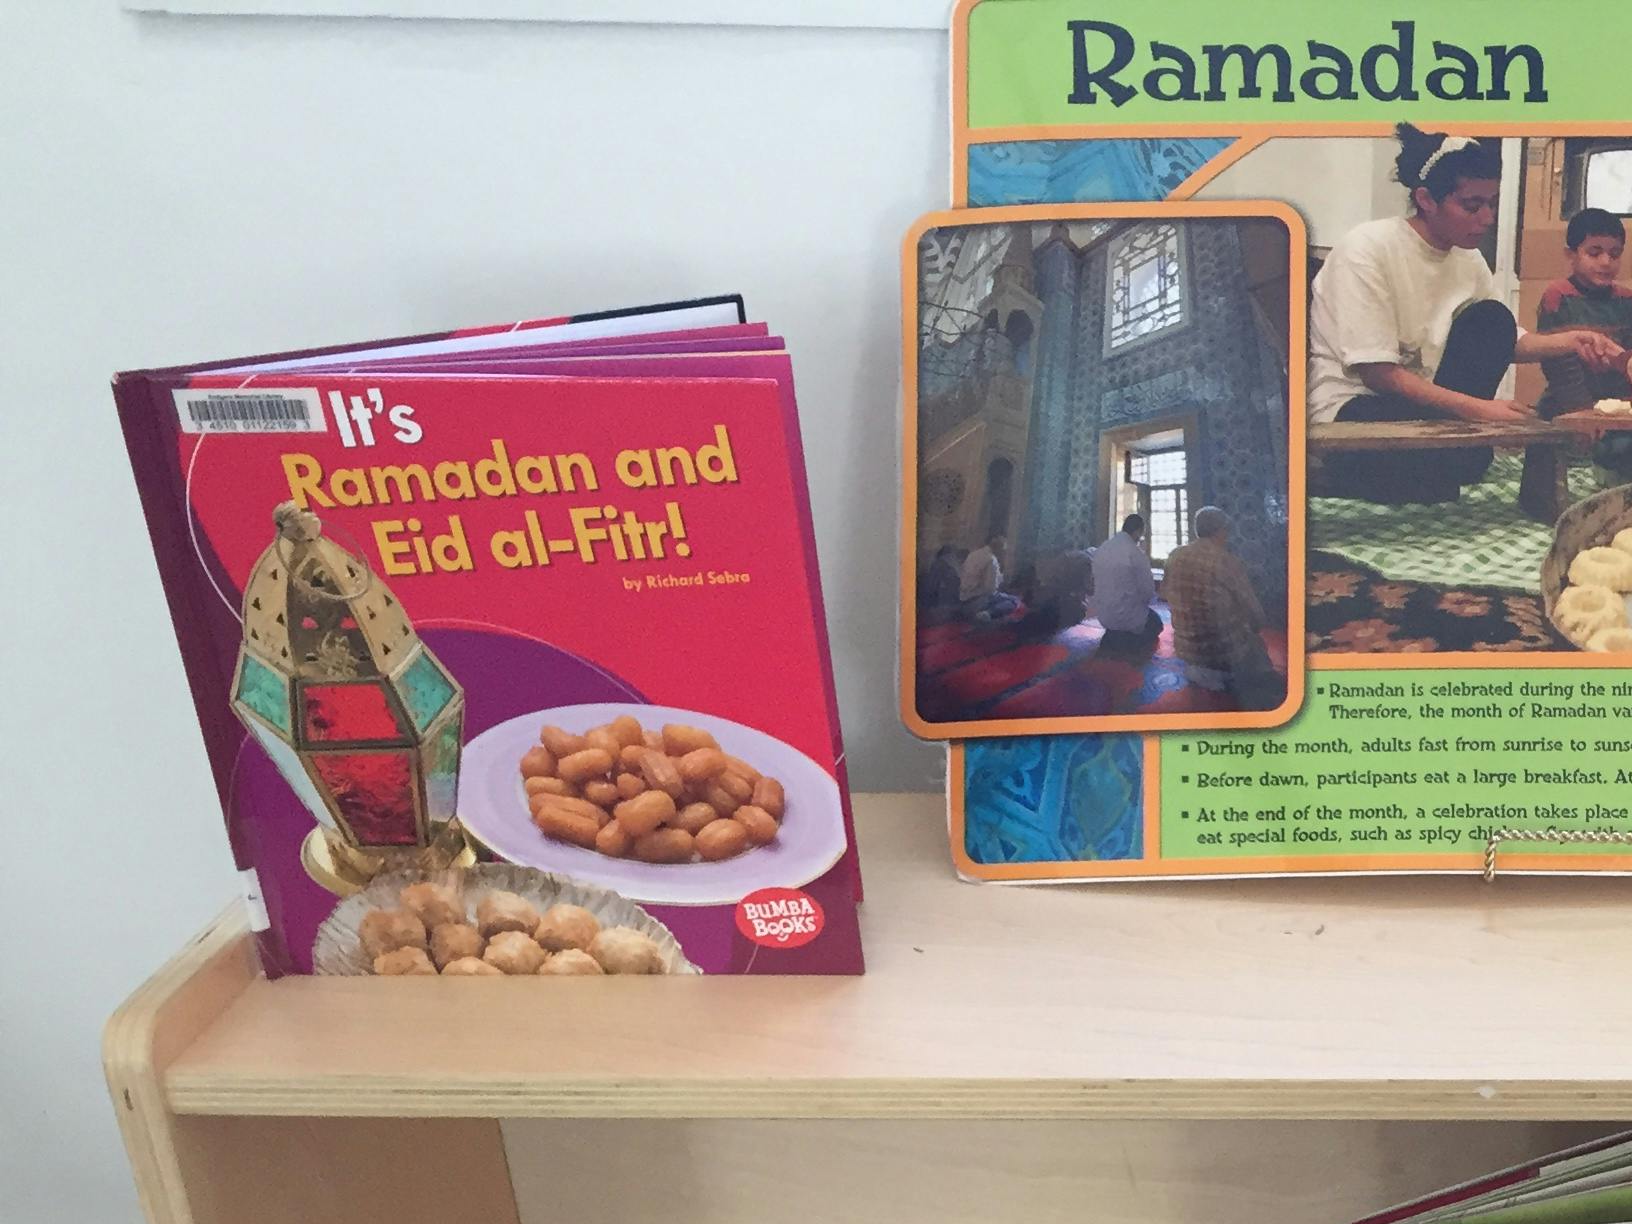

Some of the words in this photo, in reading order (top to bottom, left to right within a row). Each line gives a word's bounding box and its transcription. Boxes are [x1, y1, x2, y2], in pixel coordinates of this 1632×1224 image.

[1067, 20, 1549, 107] Ramadan
[327, 388, 423, 448] It's
[280, 439, 599, 511] Ramadan
[615, 425, 739, 488] and
[372, 518, 474, 577] Eid
[492, 503, 691, 569] al-Fitr!
[622, 578, 642, 592] by
[646, 572, 704, 588] Richard
[707, 571, 750, 584] Sebra
[1330, 683, 1404, 698] Ramadan
[1411, 683, 1423, 696] is
[1430, 682, 1513, 696] celebrated
[1520, 682, 1574, 700] during
[1581, 682, 1605, 696] the
[1329, 704, 1411, 719] Therefore,
[1420, 704, 1444, 718] the
[1451, 703, 1502, 718] month
[1509, 703, 1525, 718] of
[1531, 703, 1606, 718] Ramadan
[1197, 741, 1255, 759] During
[1262, 740, 1288, 754] the
[1295, 738, 1352, 754] month,
[1361, 738, 1411, 752] adults
[1419, 737, 1448, 752] fast
[1456, 737, 1495, 751] from
[1503, 737, 1563, 751] sunrise
[1570, 739, 1586, 751] to
[1198, 772, 1252, 788] Before
[1259, 771, 1308, 786] dawn,
[1317, 770, 1417, 789] participants
[1424, 771, 1449, 784] eat
[1457, 773, 1466, 783] a
[1474, 769, 1516, 788] large
[1524, 768, 1607, 784] breakfast.
[1196, 808, 1216, 822] At
[1223, 807, 1248, 822] the
[1256, 806, 1286, 821] end
[1293, 805, 1311, 820] of
[1316, 805, 1342, 820] the
[1349, 804, 1407, 820] month,
[1416, 808, 1425, 818] a
[1432, 803, 1527, 818] celebration
[1535, 804, 1578, 818] takes
[1586, 804, 1628, 822] place
[1197, 832, 1222, 844] eat
[1229, 828, 1285, 847] special
[1293, 827, 1341, 842] foods,
[1350, 826, 1387, 841] such
[1395, 829, 1412, 840] as
[1419, 826, 1461, 844] spicy
